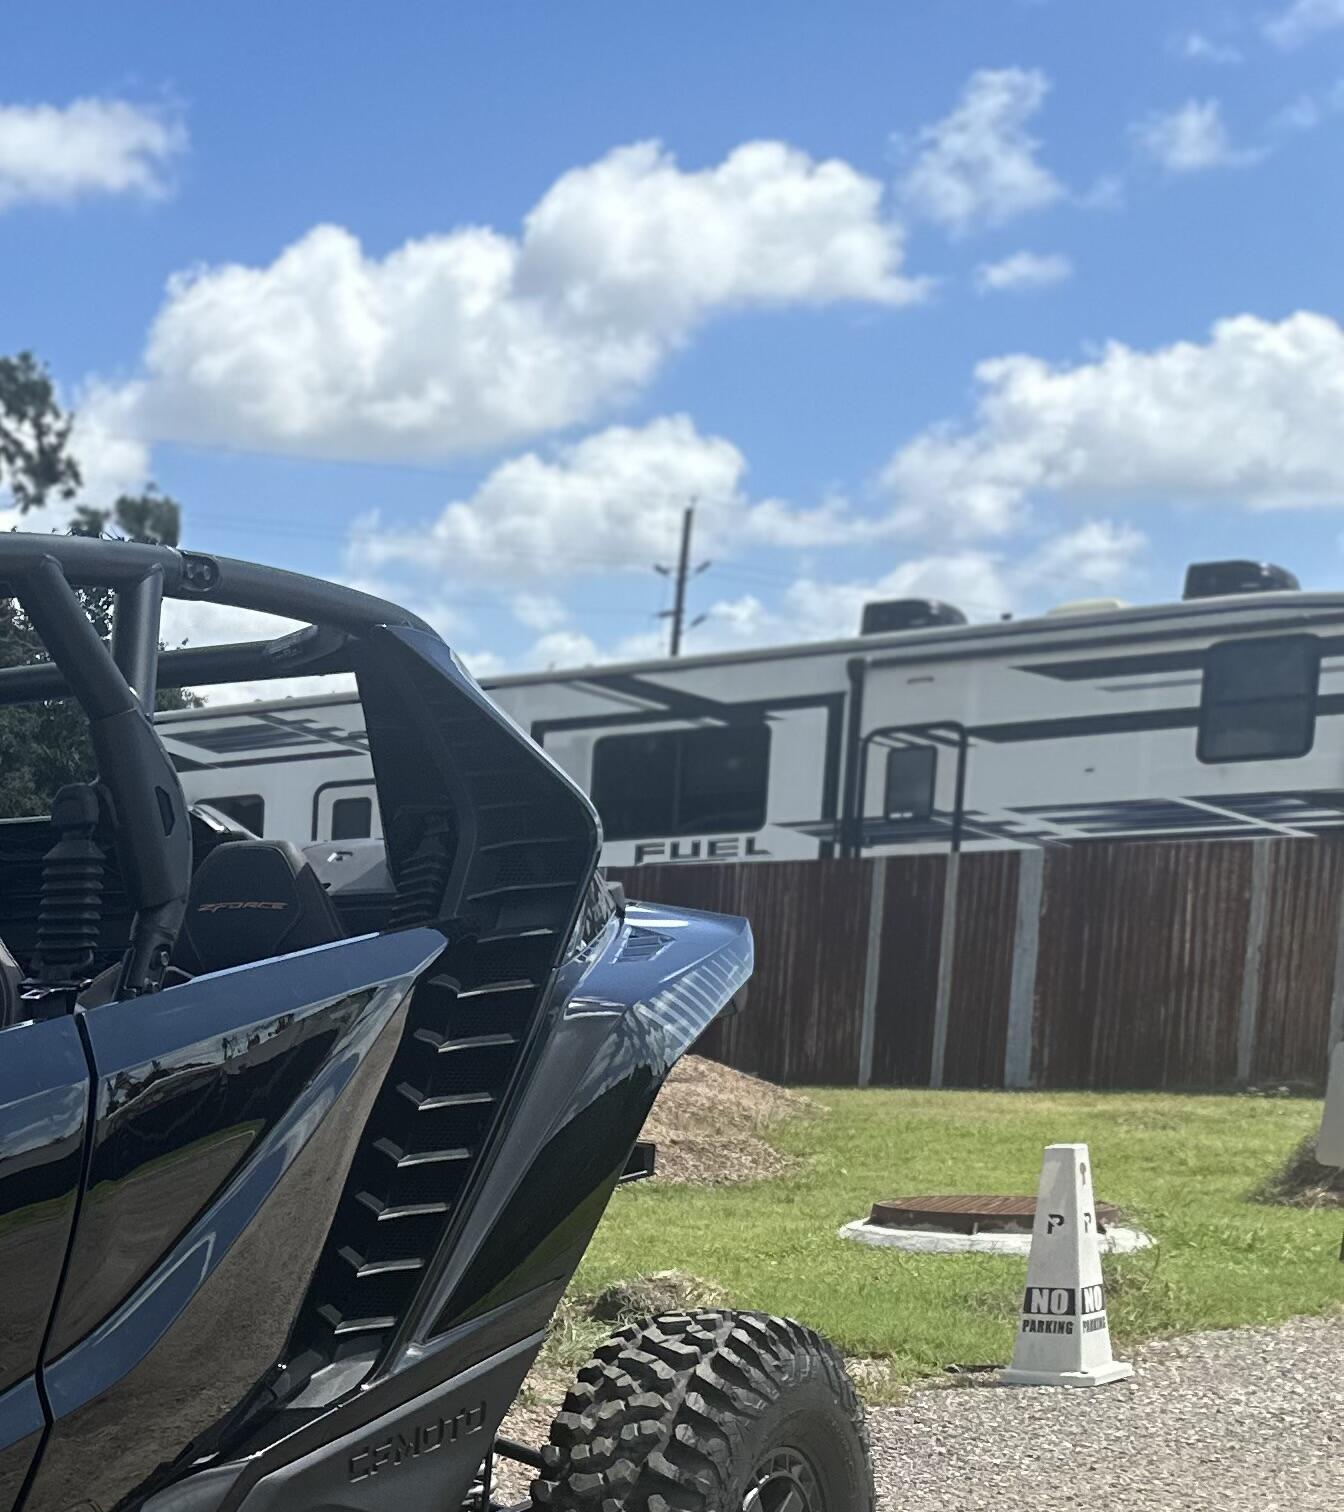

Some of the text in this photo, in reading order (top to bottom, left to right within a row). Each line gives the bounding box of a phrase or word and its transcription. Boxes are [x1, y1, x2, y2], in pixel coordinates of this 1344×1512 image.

[634, 836, 773, 866] FUEL
[1031, 1288, 1069, 1314] NO
[1083, 1286, 1102, 1313] NO
[1022, 1319, 1074, 1335] PARKING
